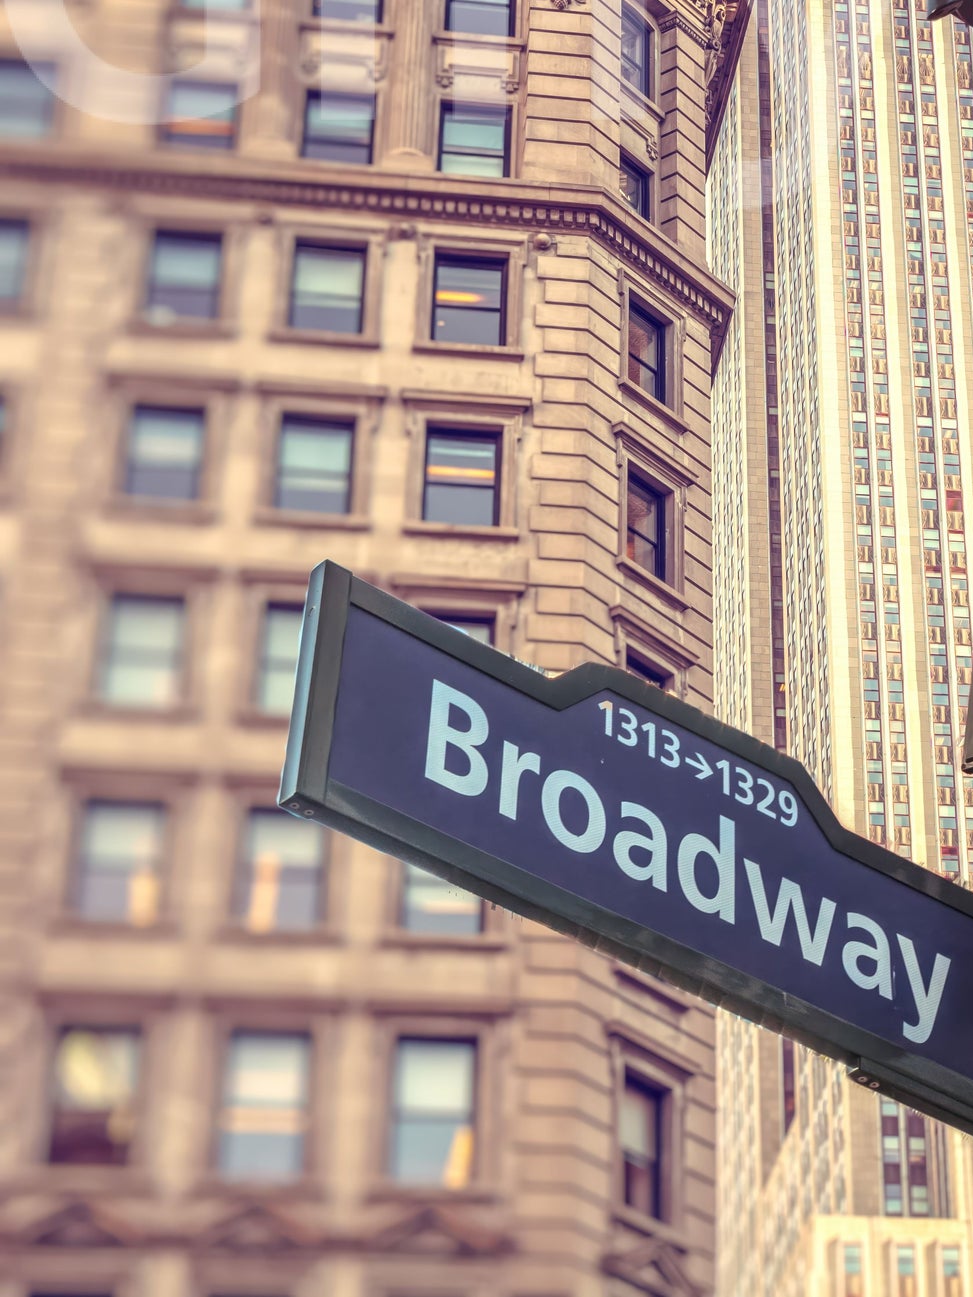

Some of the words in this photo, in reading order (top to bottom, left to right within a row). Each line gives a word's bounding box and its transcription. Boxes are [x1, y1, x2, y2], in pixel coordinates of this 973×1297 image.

[424, 678, 951, 1044] Broadway
[597, 700, 681, 768] 1313
[715, 759, 799, 827] 1329
